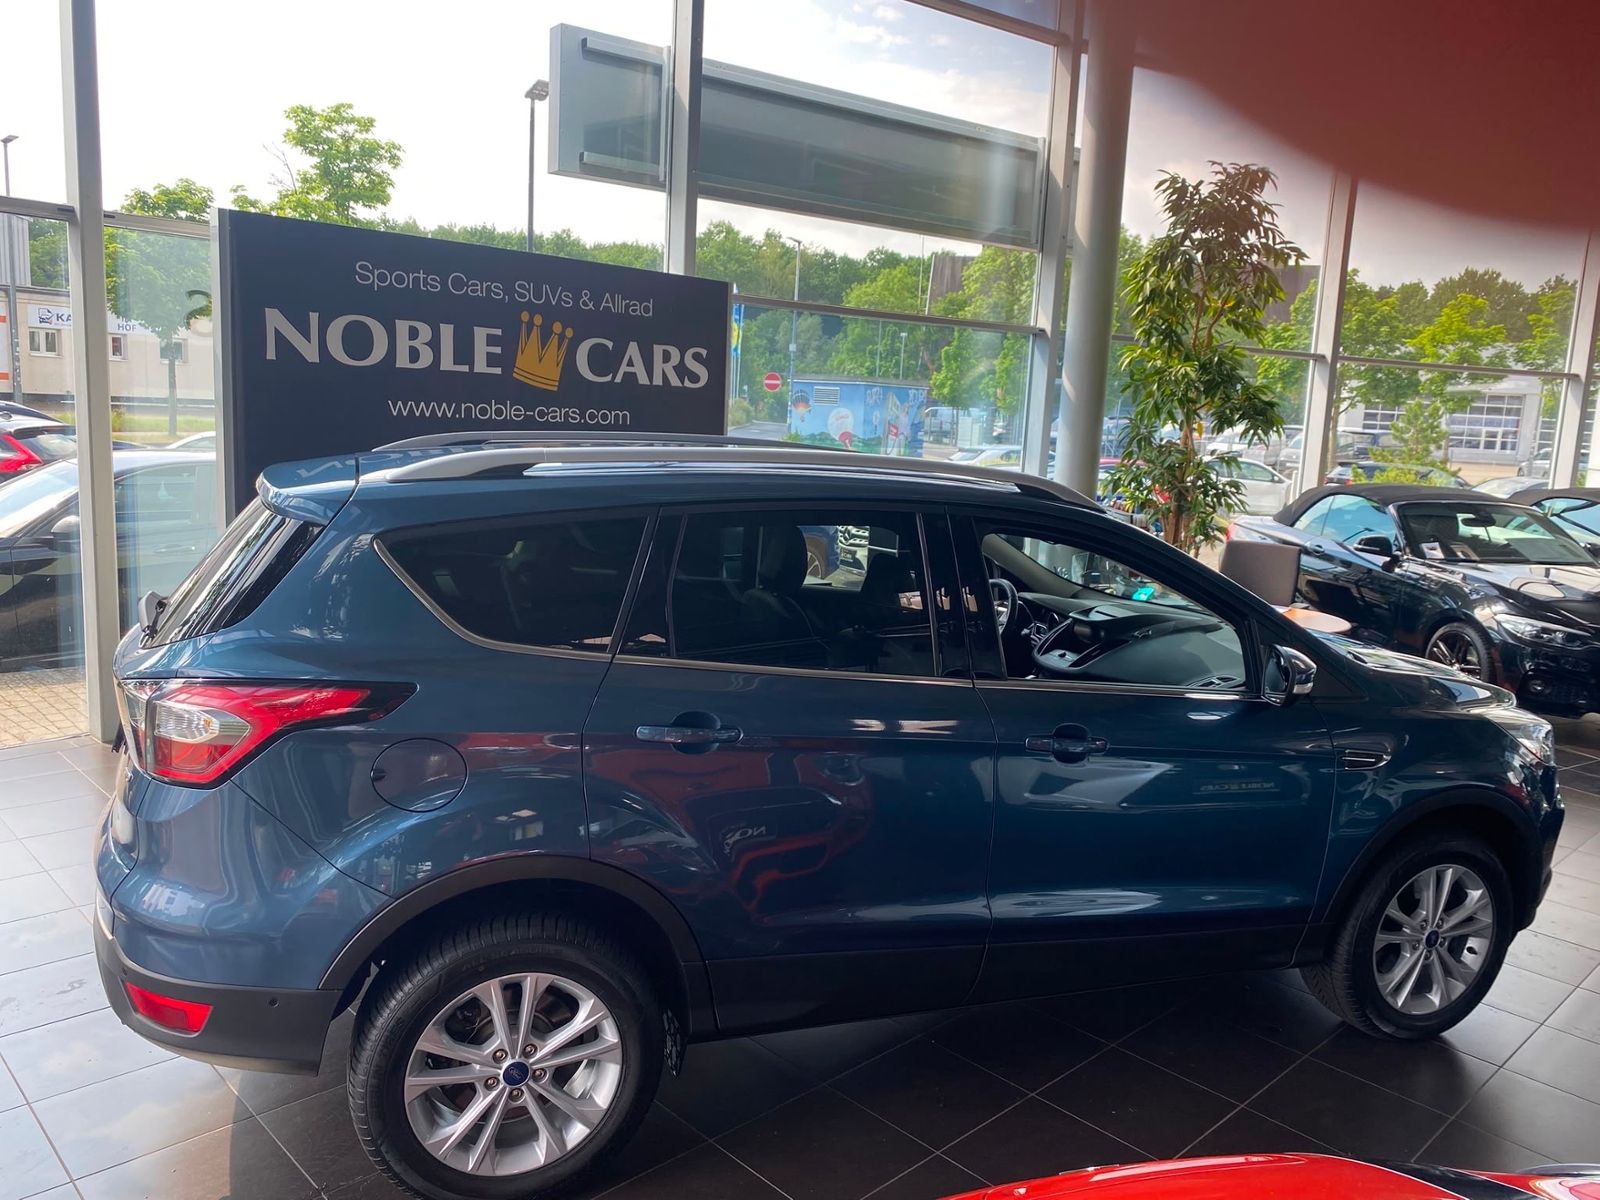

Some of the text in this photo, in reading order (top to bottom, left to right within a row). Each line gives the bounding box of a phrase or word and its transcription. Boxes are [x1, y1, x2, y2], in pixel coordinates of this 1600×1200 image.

[355, 261, 653, 317] Sports Cars, SUVs & Allrad
[264, 307, 709, 389] NOBLE CARS
[388, 399, 630, 425] www.noble-cars.com
